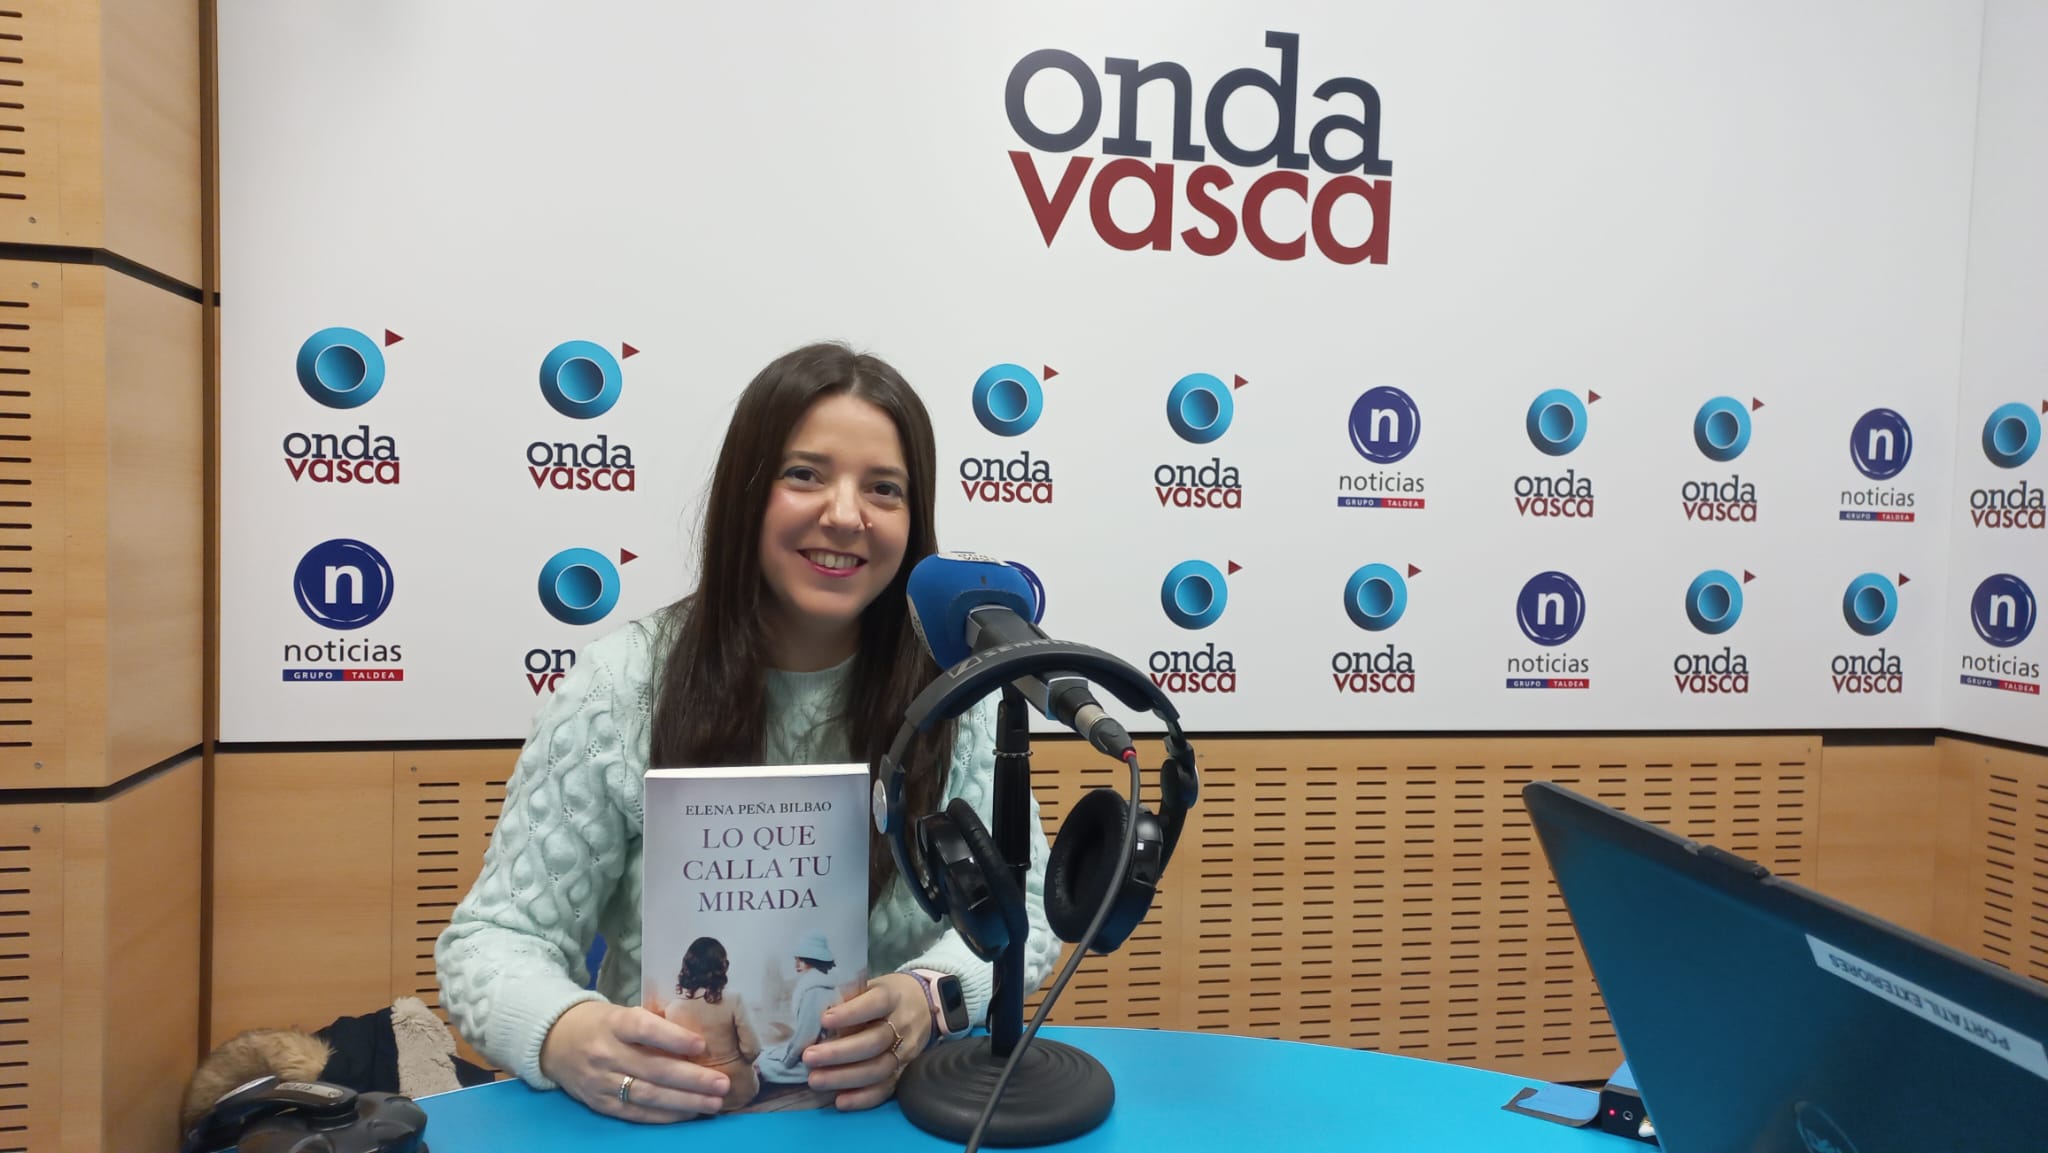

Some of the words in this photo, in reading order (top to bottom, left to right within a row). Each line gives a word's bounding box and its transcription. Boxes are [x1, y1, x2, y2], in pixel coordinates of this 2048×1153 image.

[1004, 30, 1393, 176] onda
[1007, 150, 1393, 265] vasca
[283, 425, 399, 461] onda
[526, 434, 635, 469] onda
[285, 458, 400, 484] vasca
[528, 466, 635, 491] vasca
[960, 451, 1053, 483] onda
[1154, 458, 1241, 489] onda
[961, 480, 1053, 503] vasca
[1338, 472, 1425, 493] noticias
[1514, 469, 1594, 500] onda
[1682, 475, 1757, 504] onda
[1970, 480, 2046, 510] onda
[1155, 487, 1242, 509] vasca
[1515, 498, 1595, 518] vasca
[1841, 487, 1915, 507] noticias
[1683, 502, 1758, 522] vasca
[1971, 508, 2047, 529] vasca
[284, 638, 402, 663] noticias
[524, 648, 577, 674] on
[1149, 642, 1236, 674] onda
[1332, 644, 1415, 674] onda
[1507, 653, 1589, 673] noticias
[1674, 647, 1749, 676] onda
[1831, 648, 1902, 676] onda
[293, 671, 333, 679] GRUPO
[352, 671, 395, 680] TALDEA
[1961, 654, 2040, 678] noticias
[1149, 672, 1236, 693] vasca
[1333, 673, 1415, 693] vasca
[1675, 674, 1749, 693] vasca
[1832, 675, 1902, 693] vasca
[685, 804, 734, 816] ELENA
[738, 801, 776, 815] PEÑA
[780, 801, 832, 813] BILBAO
[702, 827, 744, 849] LO
[753, 825, 816, 850] QUE
[683, 858, 784, 881] CALLA
[790, 855, 832, 877] TU
[698, 888, 819, 913] MIRADA
[1828, 953, 1924, 1008] EXTERIORES
